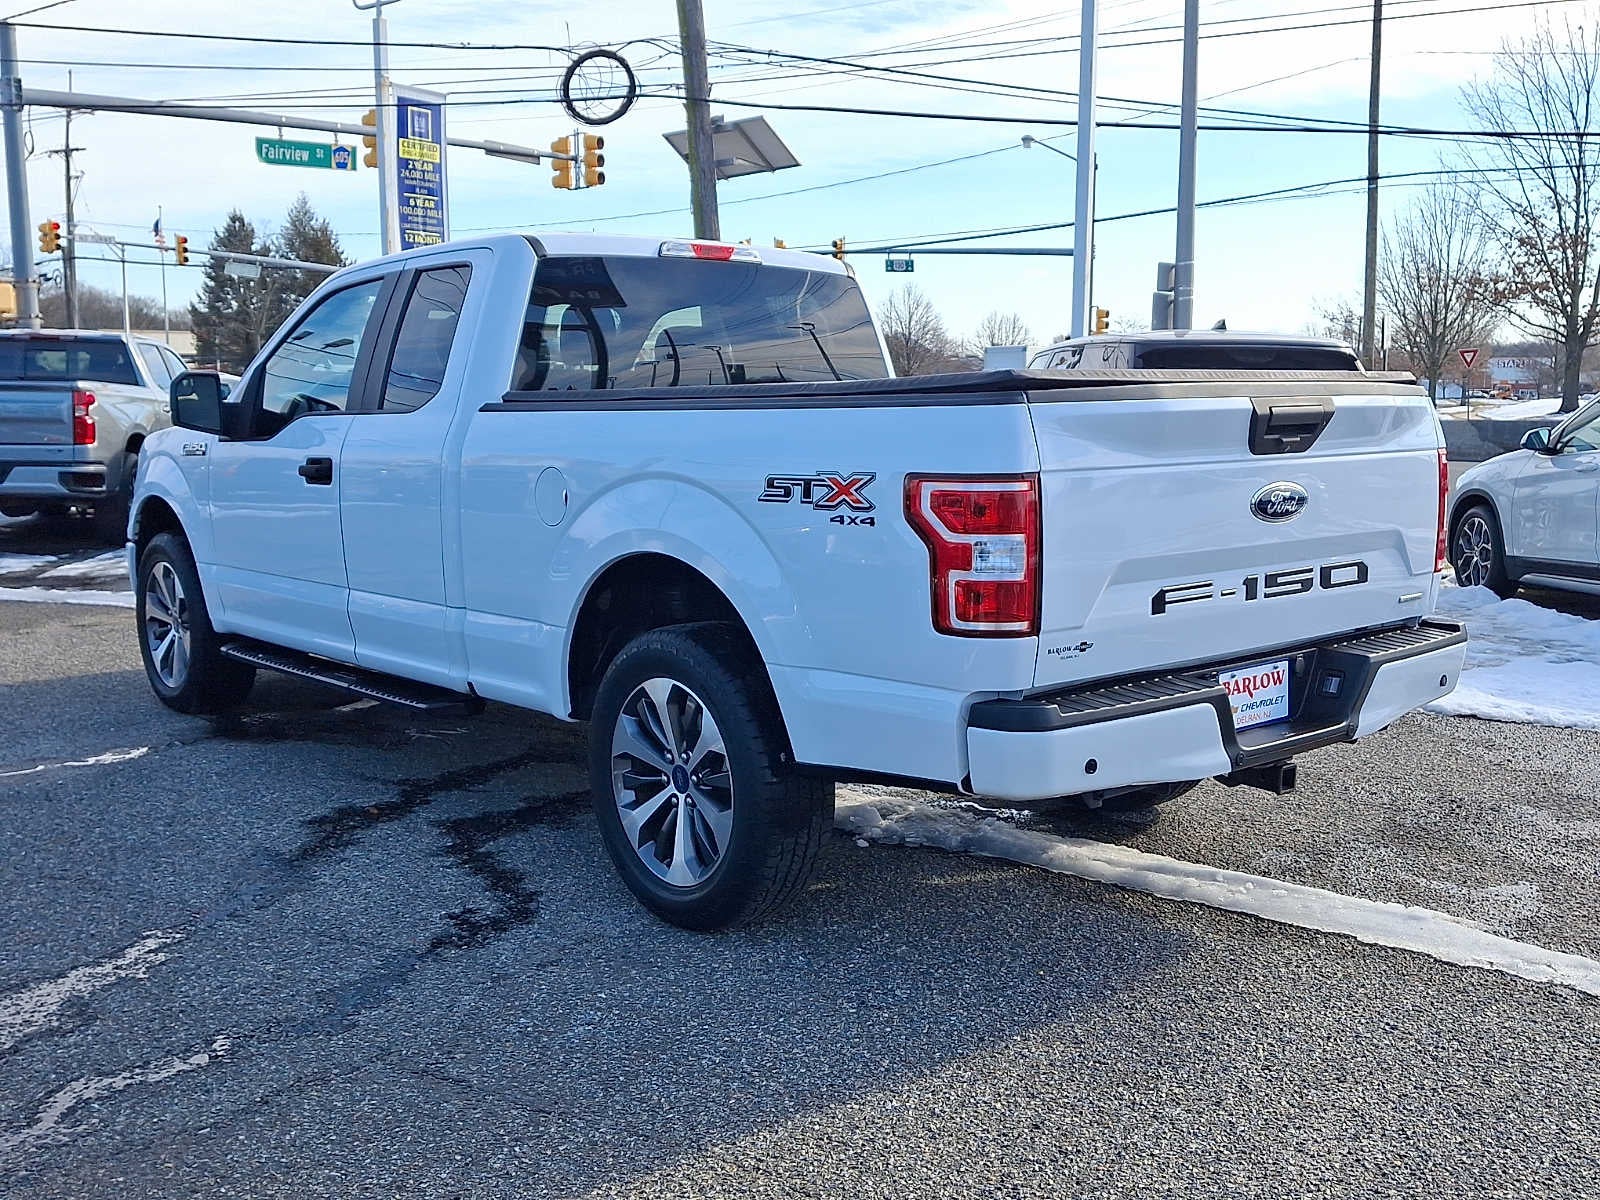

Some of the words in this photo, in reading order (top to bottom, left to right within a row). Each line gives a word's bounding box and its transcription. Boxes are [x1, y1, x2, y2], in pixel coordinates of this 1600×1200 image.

[261, 143, 310, 162] Fairview
[315, 148, 324, 159] St
[401, 140, 438, 153] CERTIFIED
[334, 151, 350, 163] 605
[407, 160, 414, 170] 2
[414, 161, 434, 172] YEAR
[400, 168, 424, 179] 24,000
[425, 172, 441, 182] MILE
[409, 197, 416, 206] 6
[416, 198, 435, 208] YEAR
[399, 205, 426, 216] 100,000
[427, 209, 443, 218] MILE
[404, 233, 415, 243] 12
[415, 234, 442, 245] MONTH
[758, 470, 877, 512] STX
[1266, 490, 1299, 514] Ford
[1151, 558, 1369, 616] F-150
[1222, 669, 1286, 699] BARLOW
[1240, 695, 1286, 713] CHEVROLET
[1263, 710, 1272, 719] NJ
